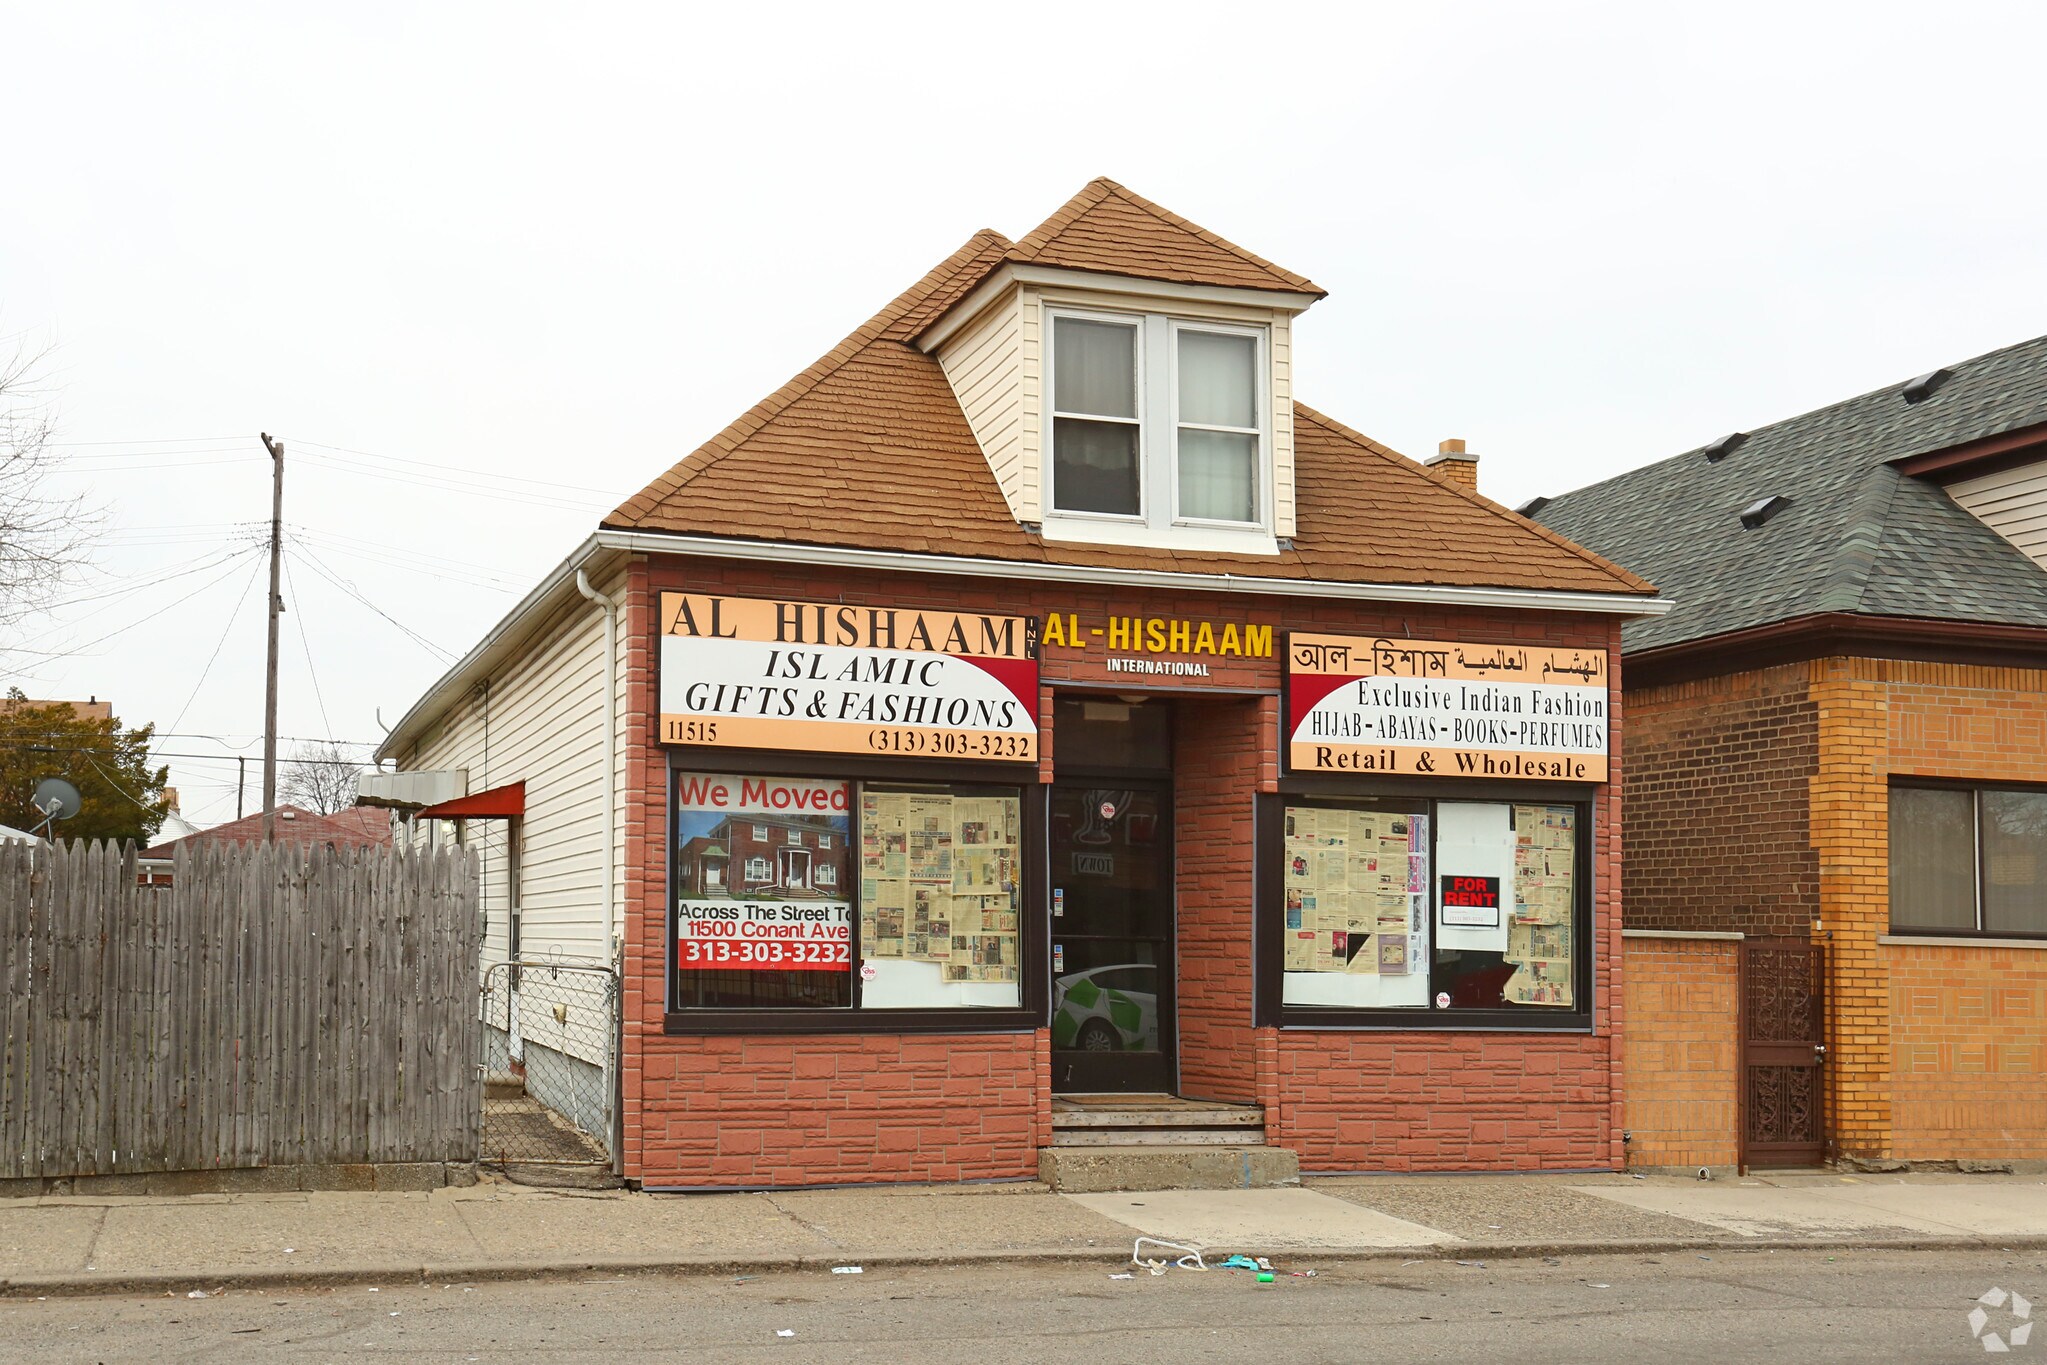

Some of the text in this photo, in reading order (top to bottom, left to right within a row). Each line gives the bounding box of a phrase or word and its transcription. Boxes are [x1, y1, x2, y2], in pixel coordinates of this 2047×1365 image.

[668, 596, 1017, 657] AL HISHAAM
[763, 650, 945, 687] ISLAMIC
[1107, 658, 1210, 677] INTERNATIONAL
[685, 682, 1016, 729] GIFTS & FASHIONS
[1358, 680, 1603, 718] Exclusive Indian Fashion
[668, 720, 717, 742] 11515
[1316, 747, 1586, 779] Retail & Wholesale
[679, 776, 849, 811] We Moved
[1454, 877, 1487, 892] FOR
[1445, 891, 1496, 906] RENT
[679, 903, 739, 920] Across
[744, 904, 778, 921] The
[781, 905, 830, 922] Street
[687, 920, 737, 938] 11500
[741, 922, 806, 939] Conant
[686, 941, 850, 964] 313-303-3232
